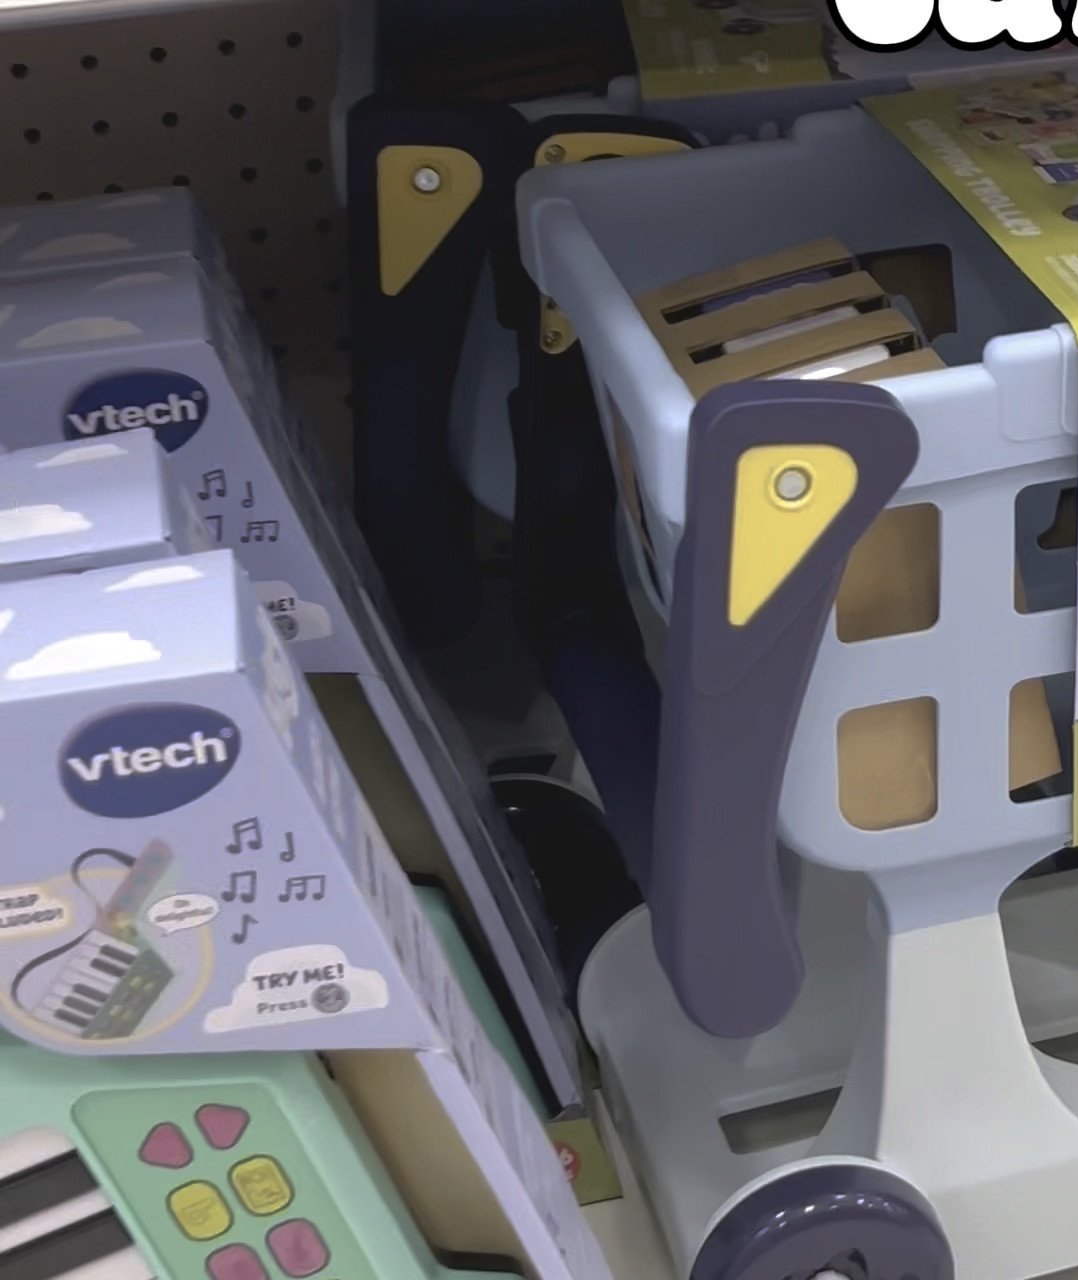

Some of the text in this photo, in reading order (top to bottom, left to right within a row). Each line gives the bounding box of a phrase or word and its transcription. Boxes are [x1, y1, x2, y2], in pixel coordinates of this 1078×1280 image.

[67, 392, 199, 435] vtech
[67, 728, 228, 785] vtech
[252, 963, 345, 992] TRY ME!
[256, 997, 309, 1015] Press
